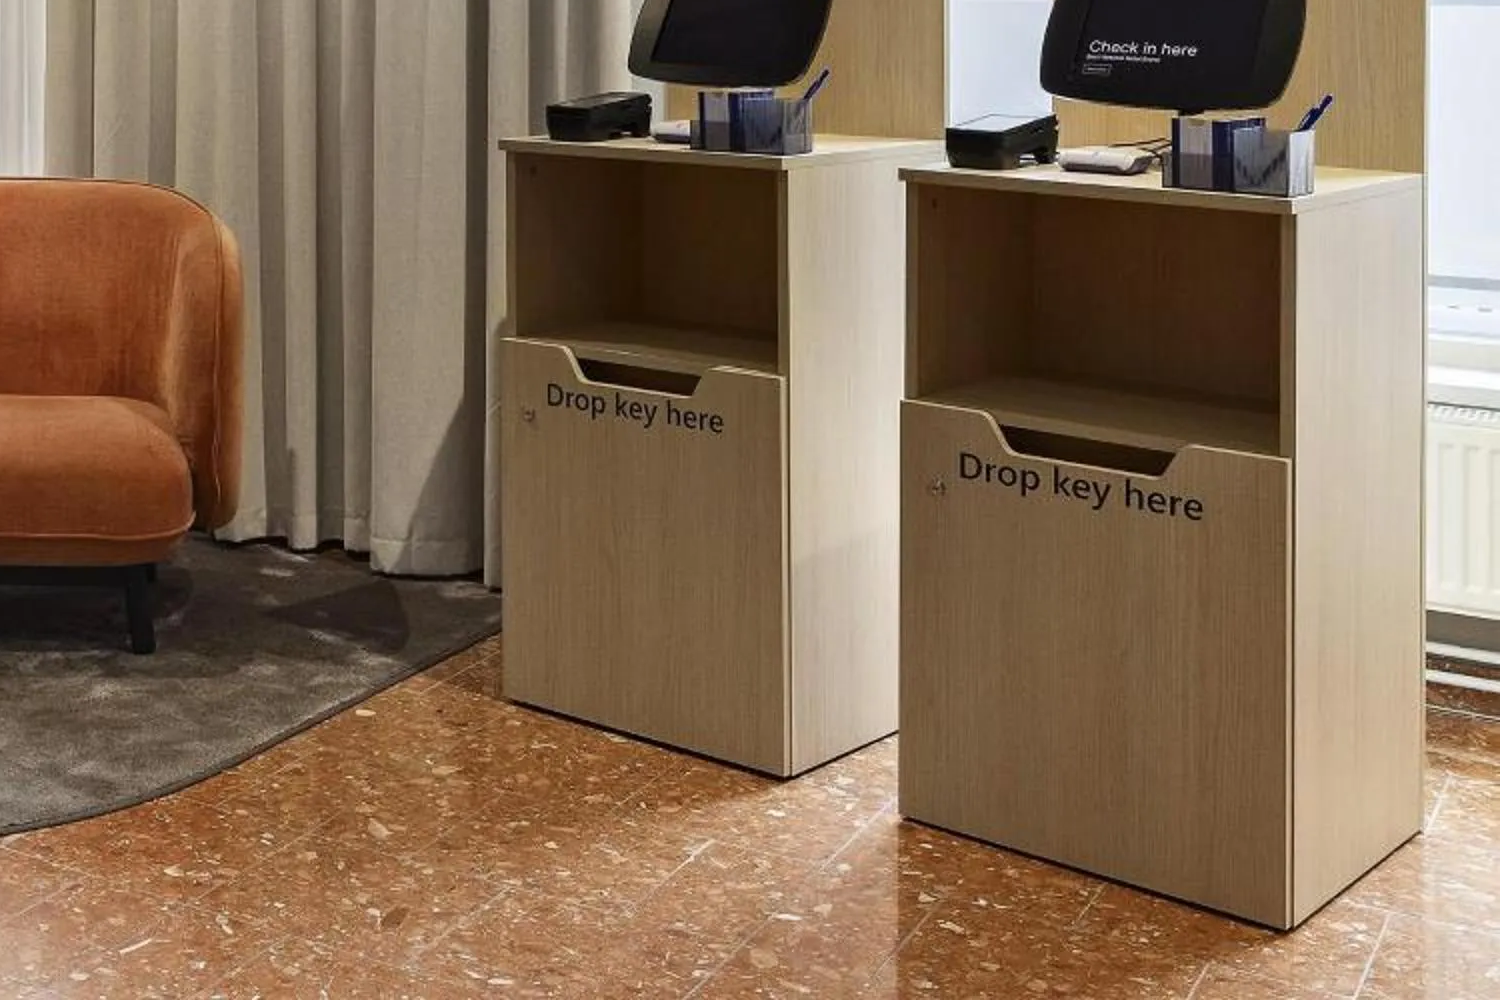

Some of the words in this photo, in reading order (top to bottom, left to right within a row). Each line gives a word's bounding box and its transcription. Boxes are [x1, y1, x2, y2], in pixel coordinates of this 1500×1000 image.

[1088, 39, 1139, 53] Check
[1143, 42, 1157, 54] in
[1161, 43, 1198, 56] here
[546, 382, 606, 421] Drop
[615, 392, 658, 429] key
[666, 400, 725, 434] here
[958, 452, 1041, 497] Drop
[1053, 466, 1111, 511] key
[1125, 479, 1204, 521] here
